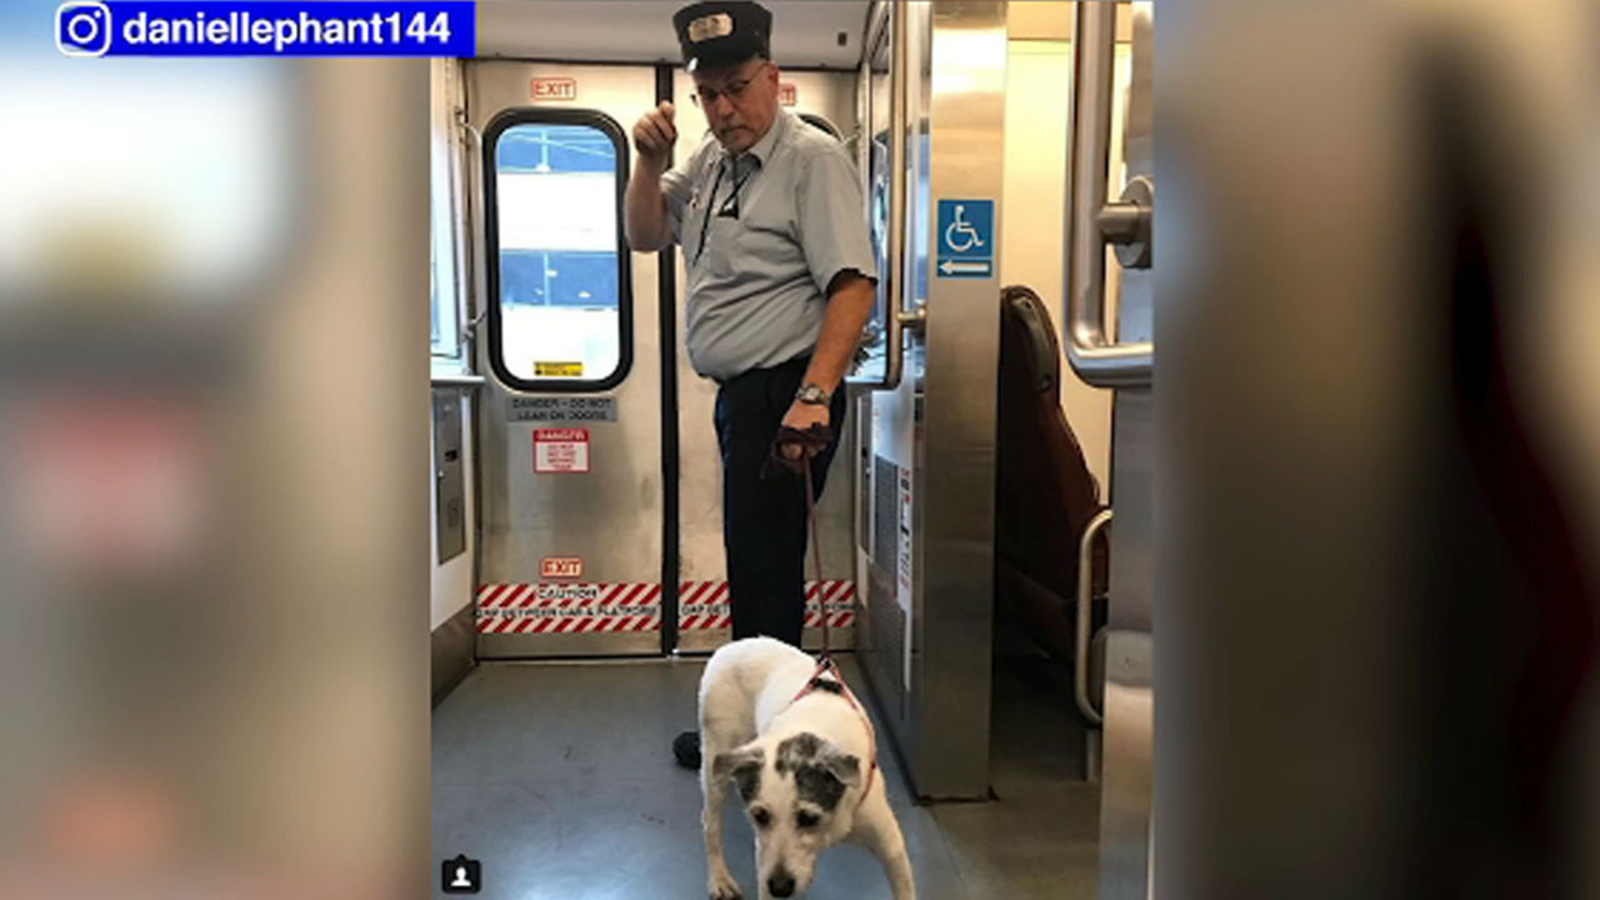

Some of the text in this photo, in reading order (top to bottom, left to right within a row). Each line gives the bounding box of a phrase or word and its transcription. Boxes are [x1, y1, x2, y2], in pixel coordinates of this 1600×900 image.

[533, 82, 572, 96] EXIT
[543, 560, 582, 574] EXIT
[538, 588, 597, 598] CAUTION
[681, 604, 705, 614] GAP
